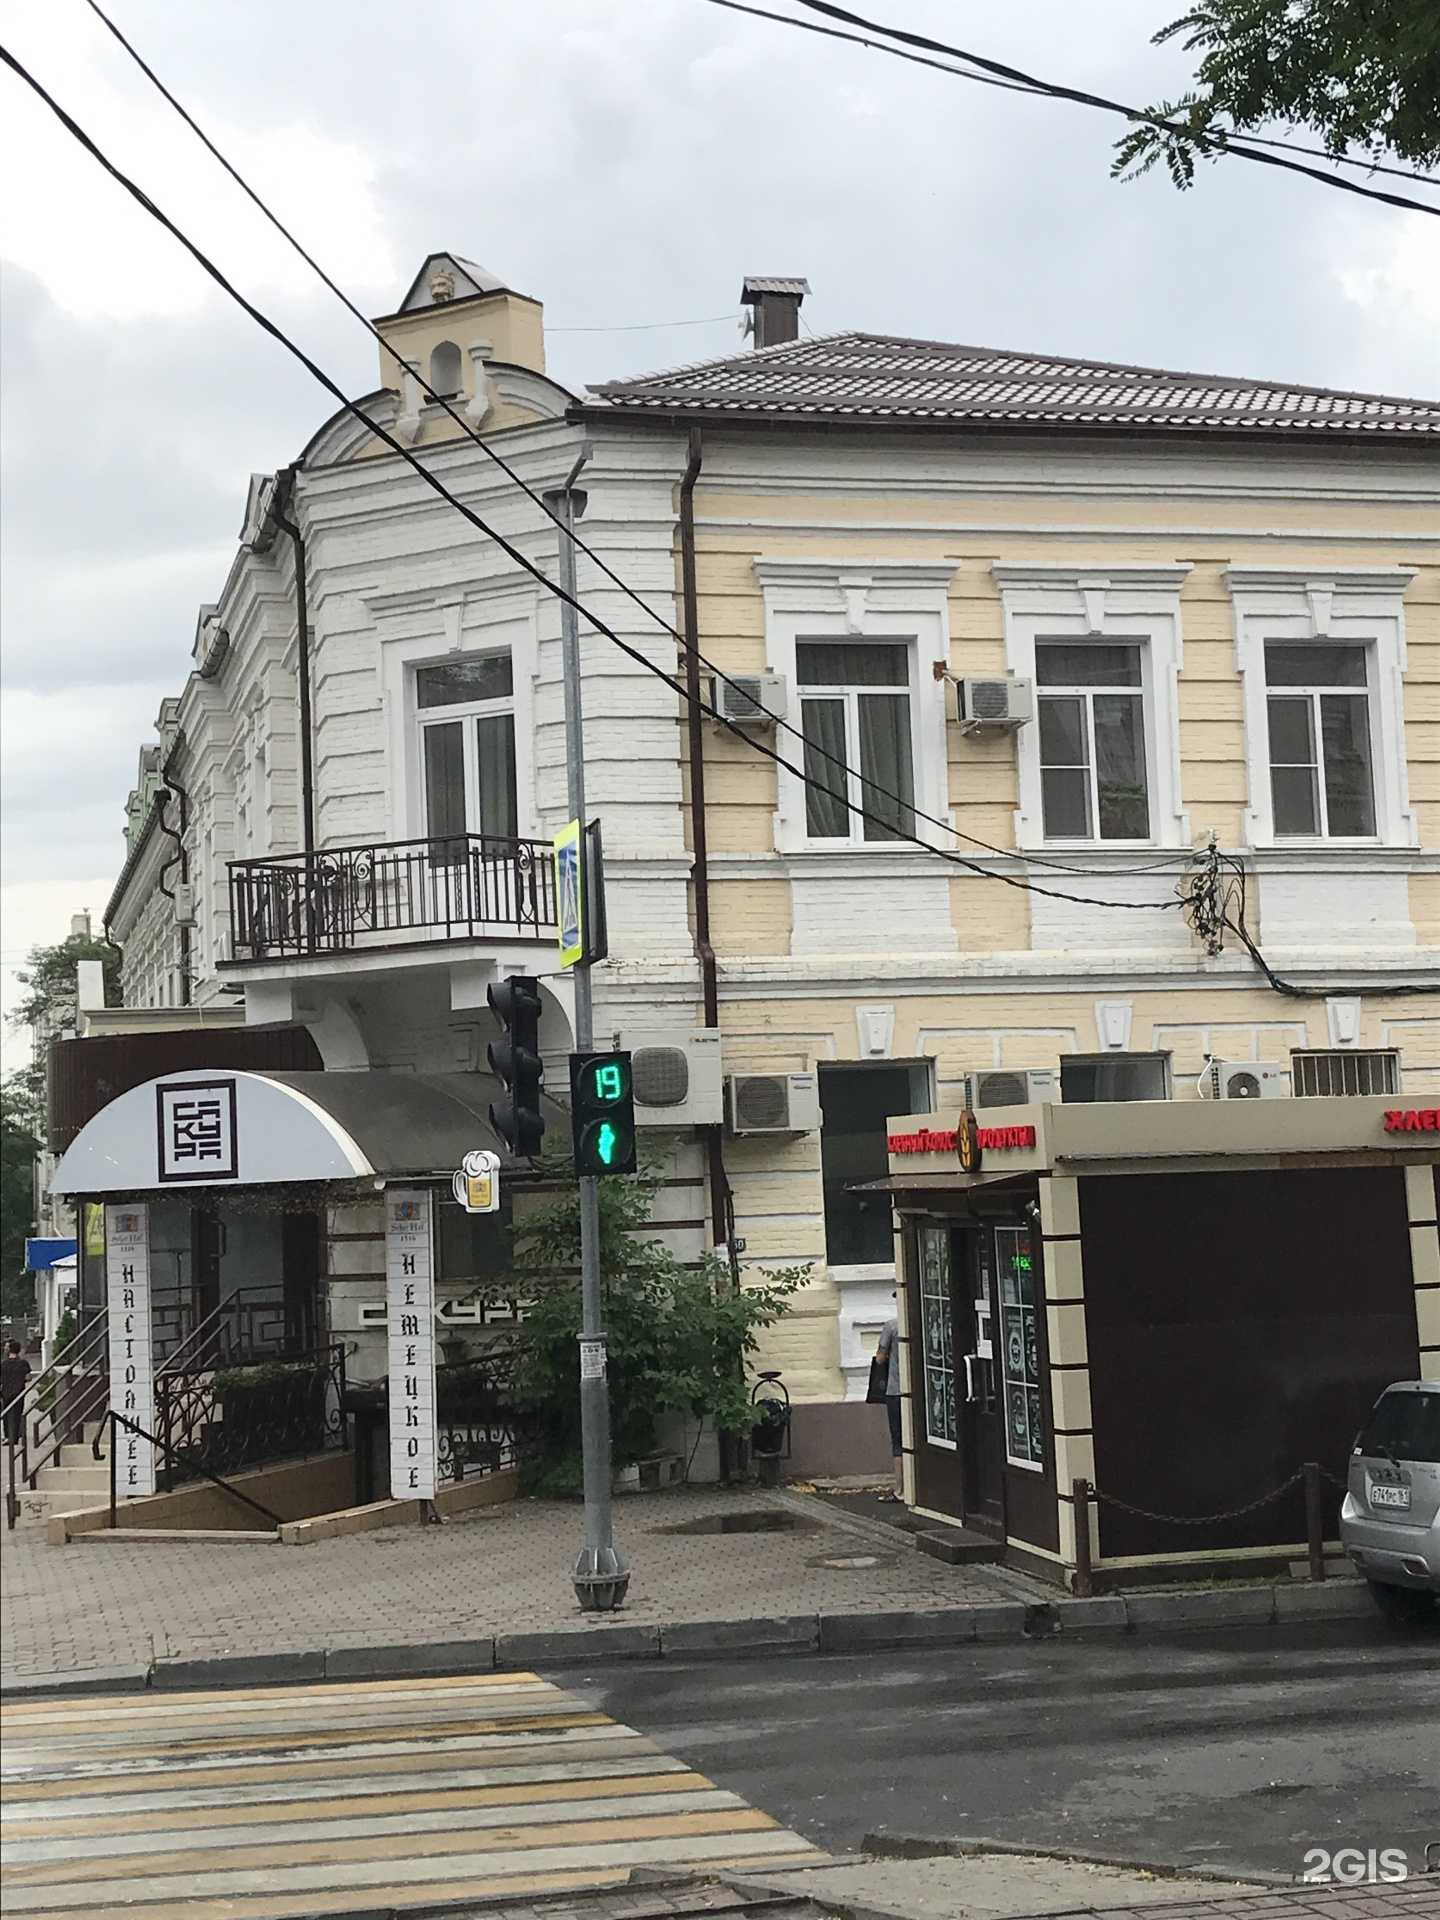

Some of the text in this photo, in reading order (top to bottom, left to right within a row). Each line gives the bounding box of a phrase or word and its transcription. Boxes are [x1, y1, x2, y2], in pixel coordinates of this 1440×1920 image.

[595, 1066, 620, 1099] 19
[1383, 1109, 1440, 1132] ХЛЕ
[401, 1254, 420, 1488] НЕМЕЦКОЕ
